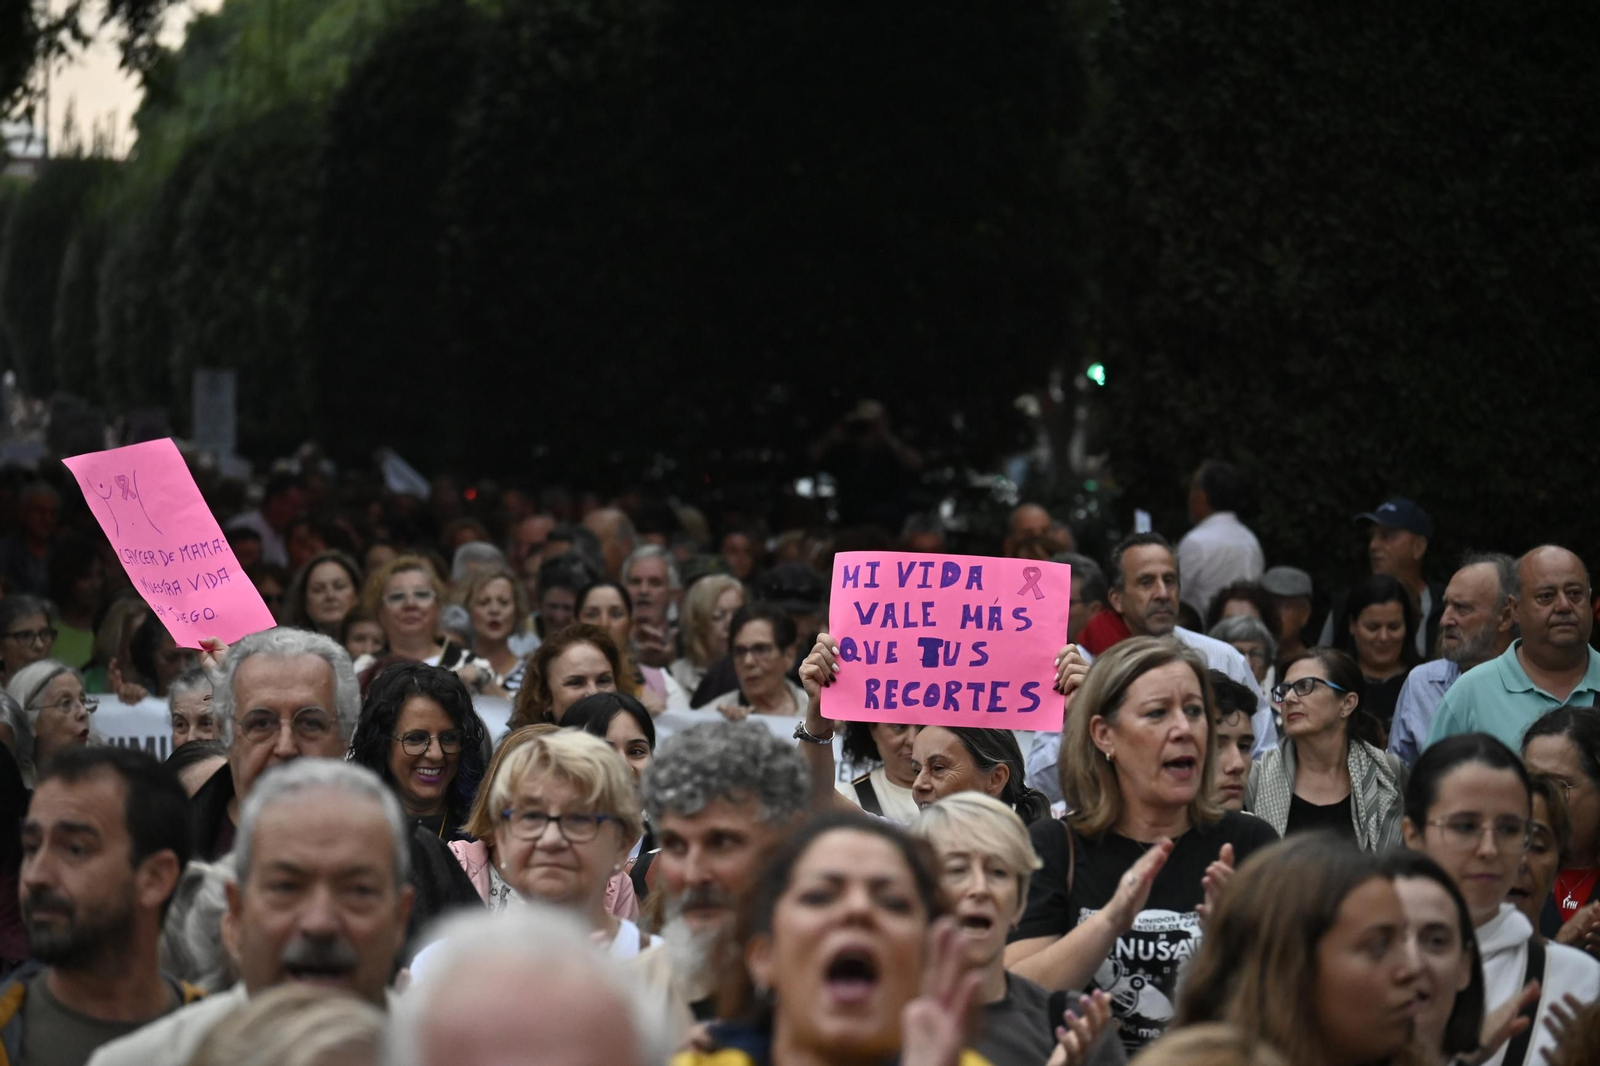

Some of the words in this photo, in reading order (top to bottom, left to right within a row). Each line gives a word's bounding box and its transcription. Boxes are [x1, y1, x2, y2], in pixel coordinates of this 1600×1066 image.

[158, 549, 175, 567] DE
[140, 577, 182, 596] NUESTRA
[187, 567, 230, 591] VIDA
[842, 561, 880, 588] MI
[897, 561, 983, 591] VIDA
[853, 601, 937, 628] VALE
[960, 597, 1033, 632] MÁS
[917, 637, 989, 668] TUS
[864, 678, 1041, 713] RECORTES
